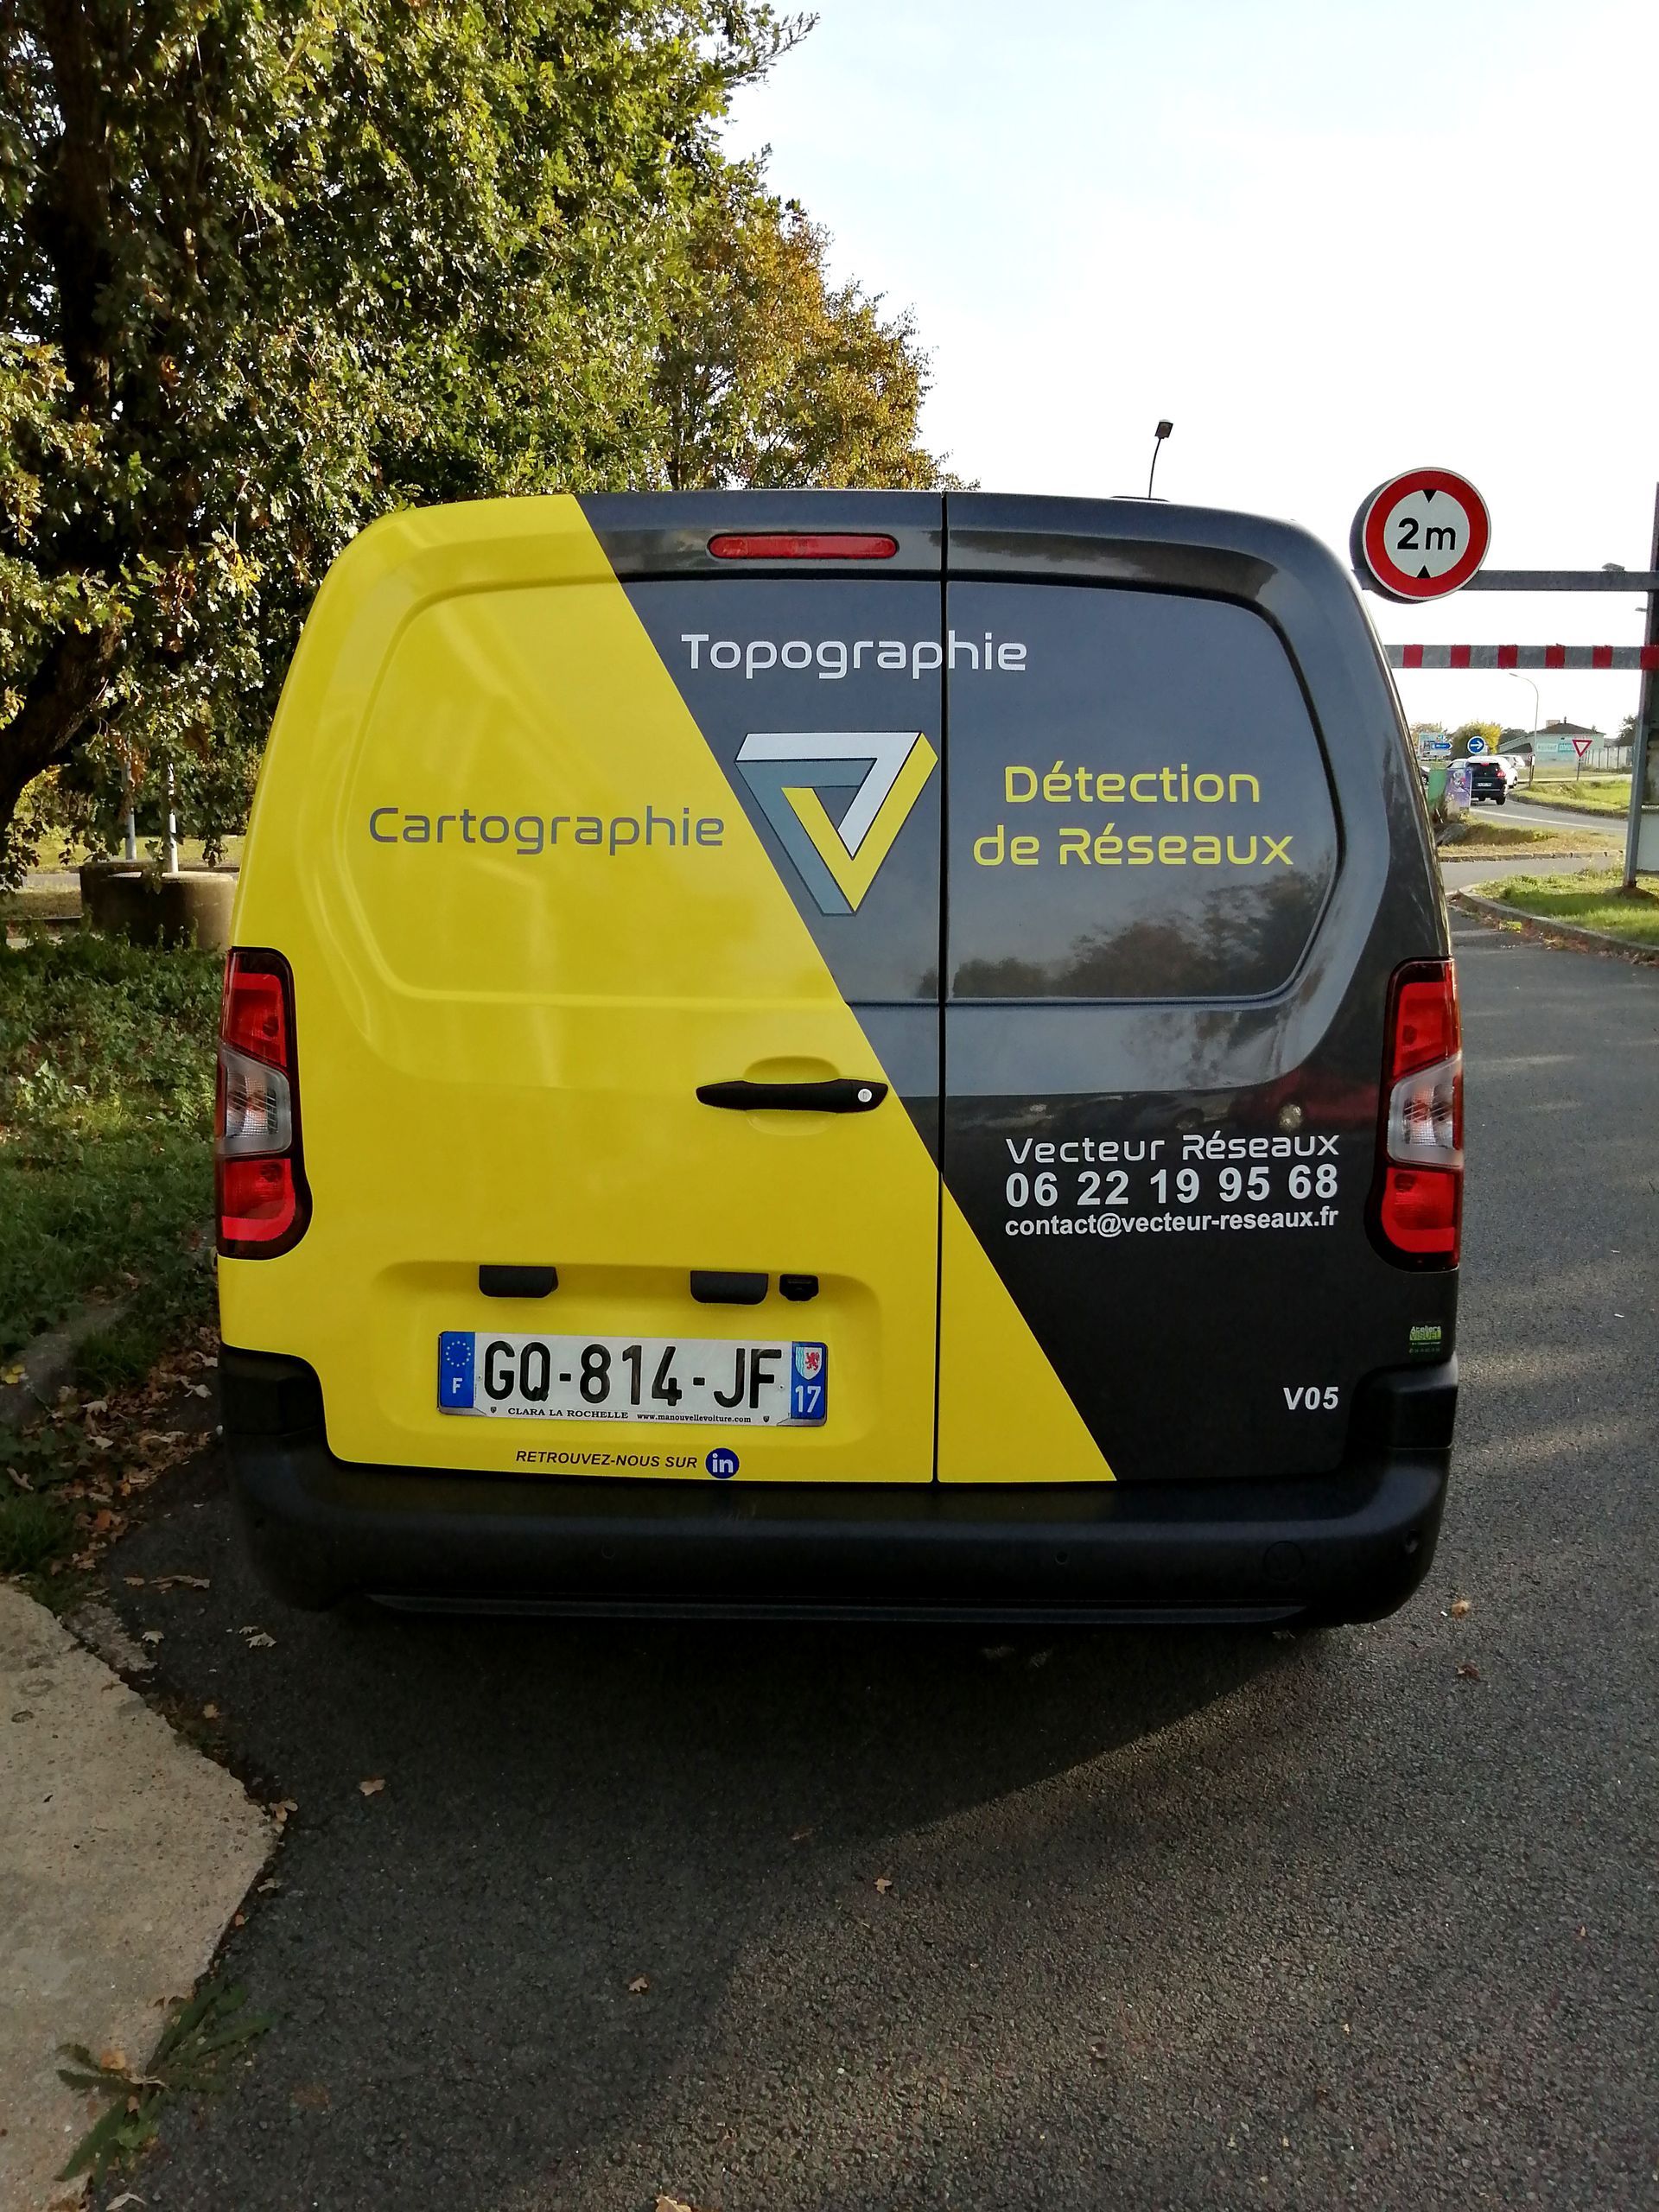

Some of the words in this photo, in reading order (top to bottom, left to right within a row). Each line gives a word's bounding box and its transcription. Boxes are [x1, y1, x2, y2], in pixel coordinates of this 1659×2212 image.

[1397, 518, 1419, 550] 2
[1425, 526, 1456, 550] m
[682, 630, 1027, 680] Topographie
[1005, 760, 1260, 803] Détection
[370, 805, 724, 855] Cartographie
[973, 825, 1039, 866] de
[1059, 823, 1294, 865] Réseaux
[1006, 1137, 1165, 1164] Vecteur
[1182, 1130, 1339, 1160] Réseaux
[1006, 1172, 1058, 1208] 06
[1077, 1170, 1129, 1205] 22
[1150, 1167, 1200, 1204] 19
[1219, 1166, 1270, 1202] 95
[1288, 1163, 1338, 1199] 68
[1005, 1205, 1338, 1238] contact@vecteur-reseaux.fr
[452, 1377, 463, 1394] F
[484, 1340, 782, 1409] GQ-814-JF
[795, 1385, 822, 1414] 17
[1282, 1386, 1339, 1410] V05
[507, 1408, 546, 1417] CLARA
[566, 1409, 629, 1420] ROCHELLE
[637, 1413, 752, 1424] www.manouvellevoiture.com
[516, 1450, 660, 1468] RETROUVEZ-NOUS
[664, 1456, 697, 1469] SUR
[712, 1452, 734, 1473] in
